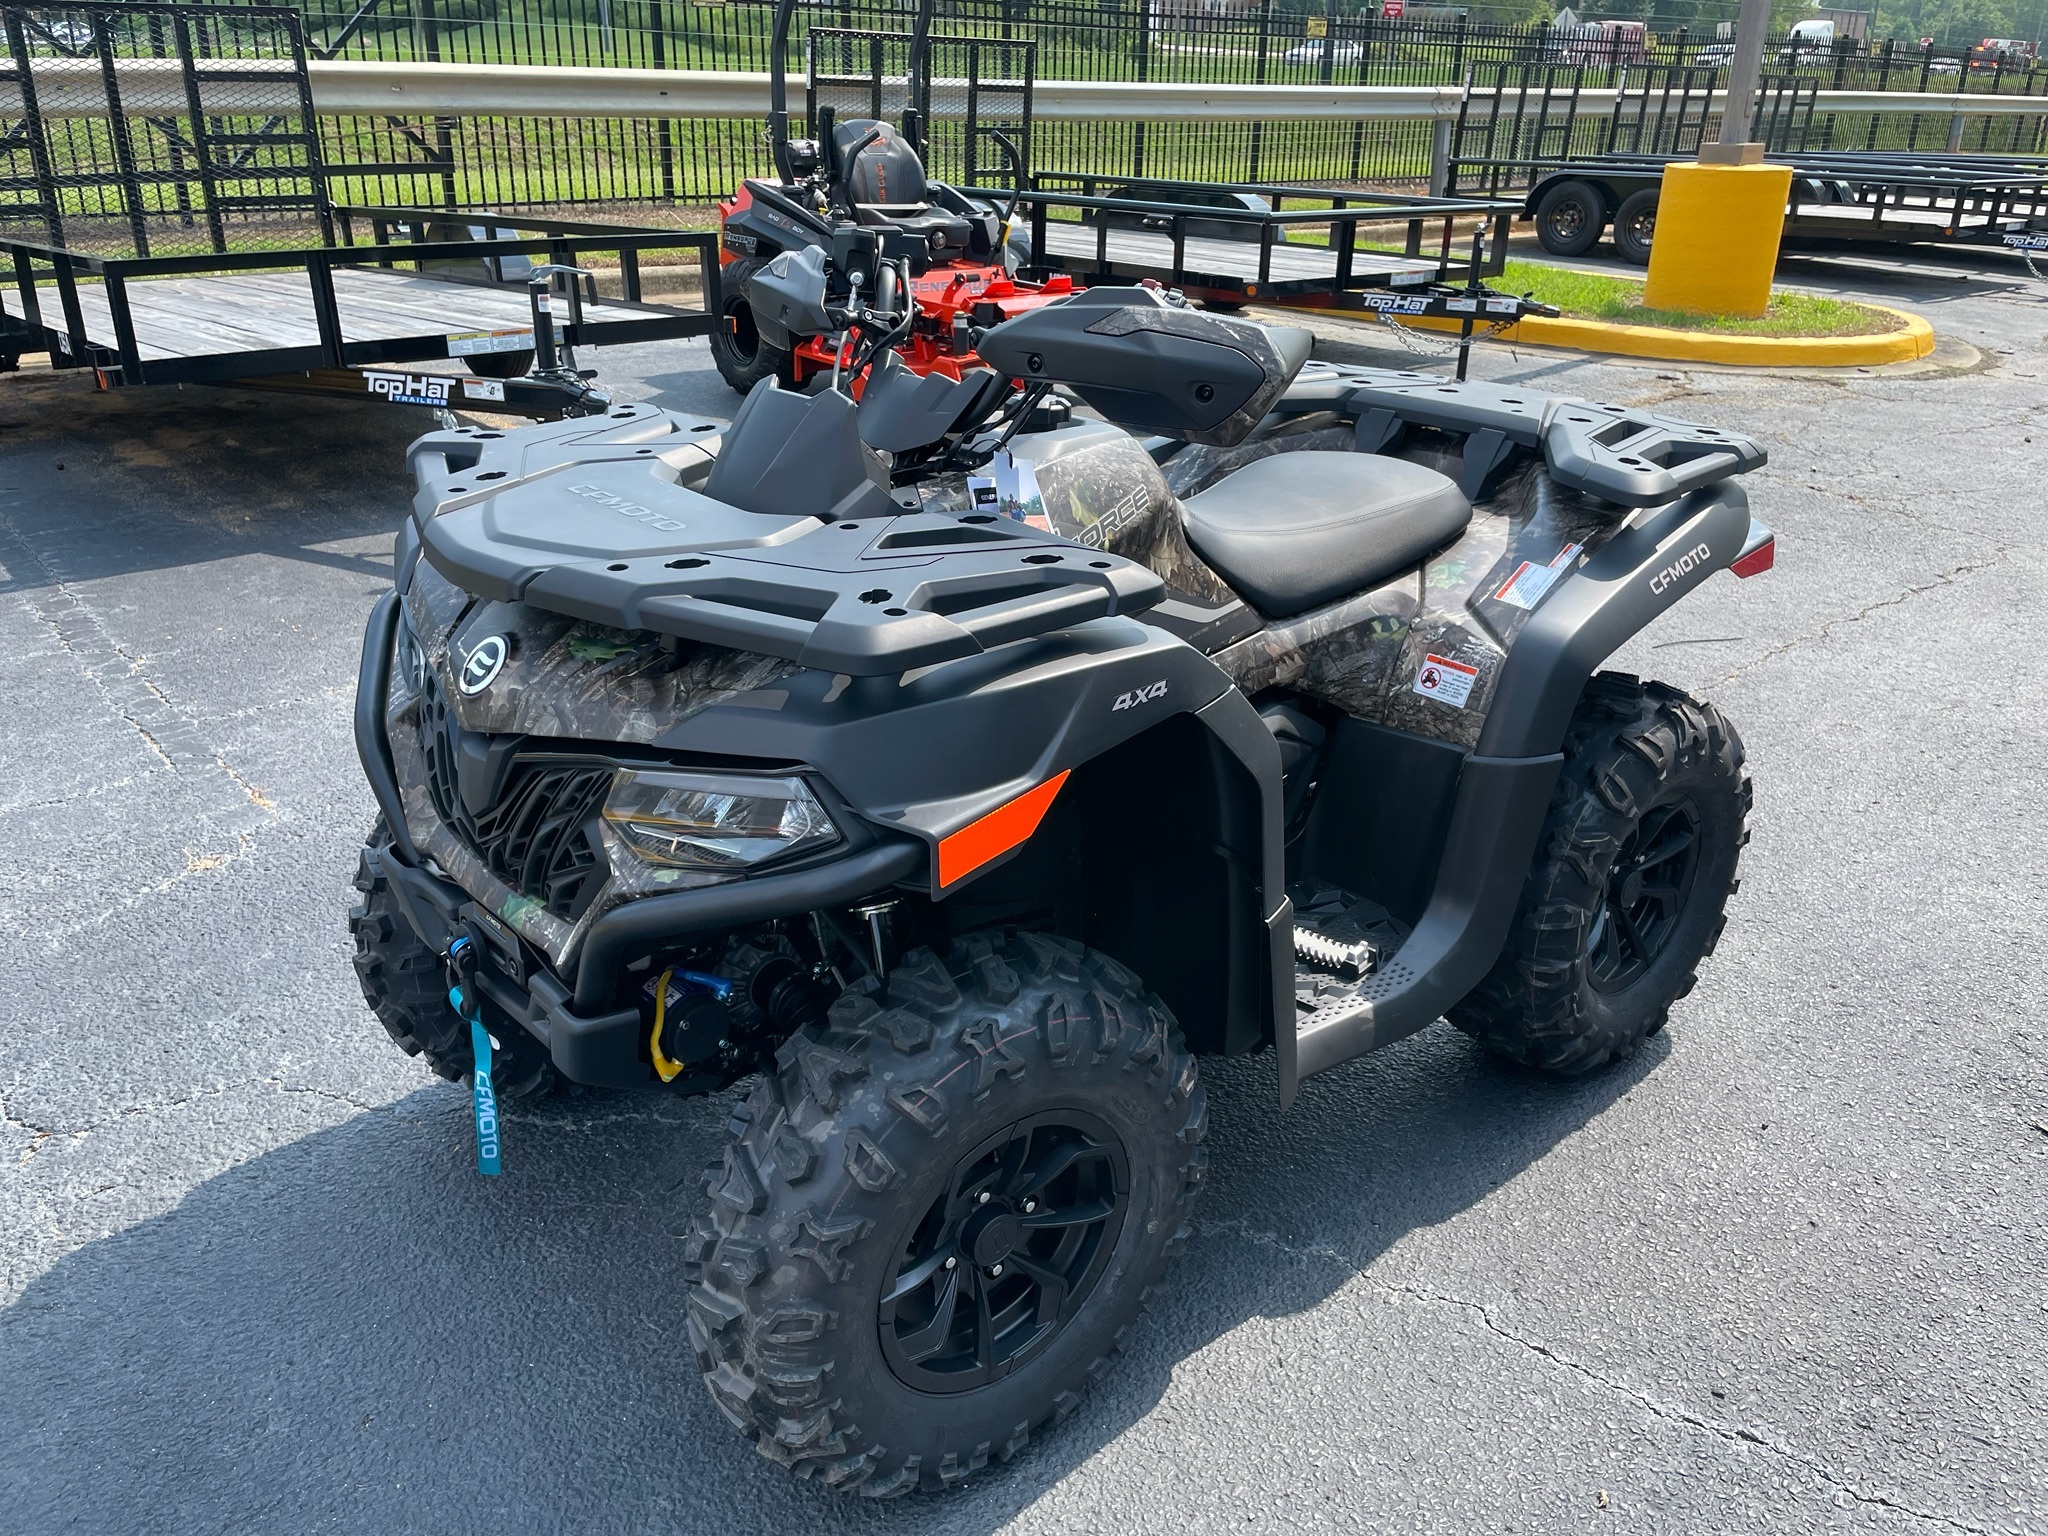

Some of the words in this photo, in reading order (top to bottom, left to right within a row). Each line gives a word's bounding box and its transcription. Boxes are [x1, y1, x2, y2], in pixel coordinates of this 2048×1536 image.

[395, 395, 447, 406] TRAILERS
[567, 484, 687, 531] CFMOTO
[1072, 485, 1150, 547] ORCE
[1649, 543, 1711, 595] CFMOTO
[477, 1070, 498, 1159] CFMOTO
